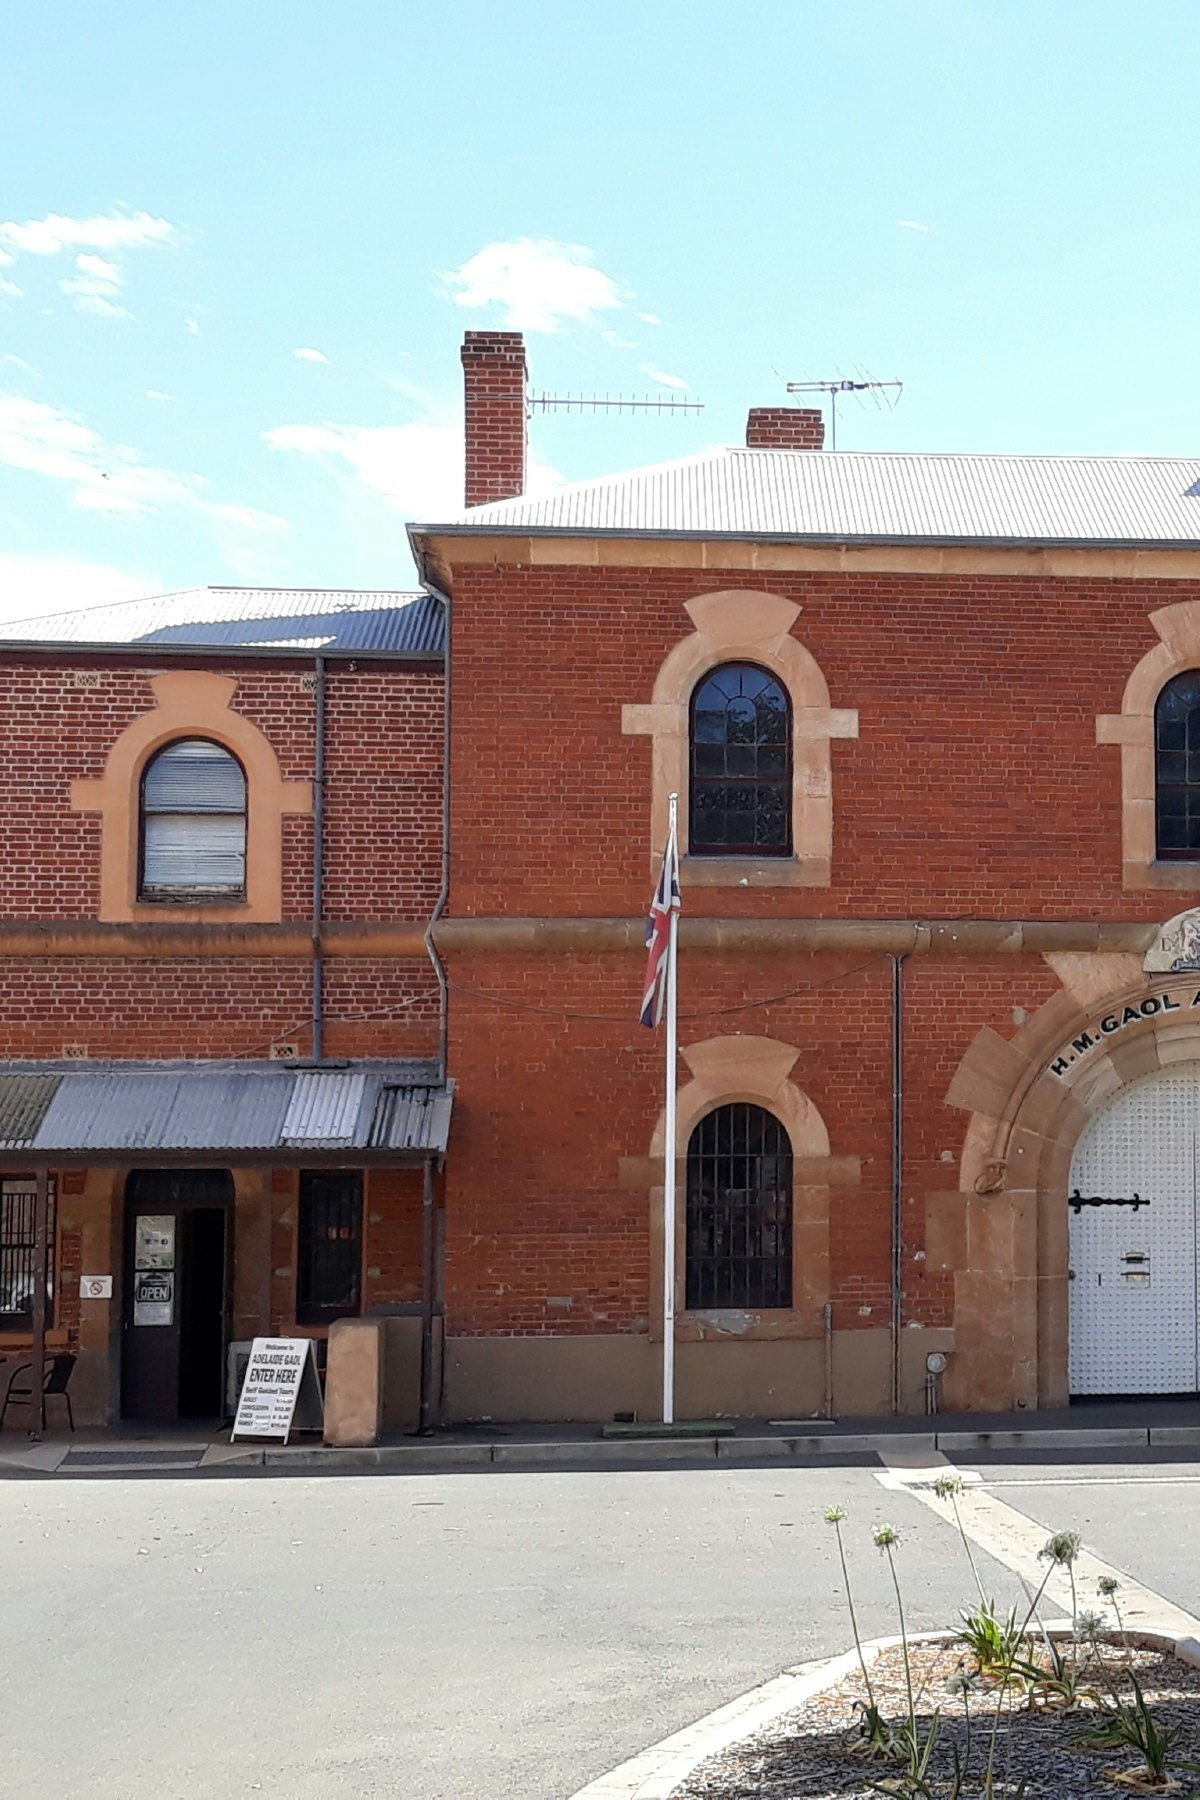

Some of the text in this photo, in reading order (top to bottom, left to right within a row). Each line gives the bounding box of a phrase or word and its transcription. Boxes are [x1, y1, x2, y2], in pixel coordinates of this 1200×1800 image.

[140, 1286, 168, 1300] OPEN
[252, 1353, 301, 1365] ADELAIDE GAOL
[249, 1368, 298, 1384] ENTER HERE
[245, 1386, 295, 1395] Self Guided Tours
